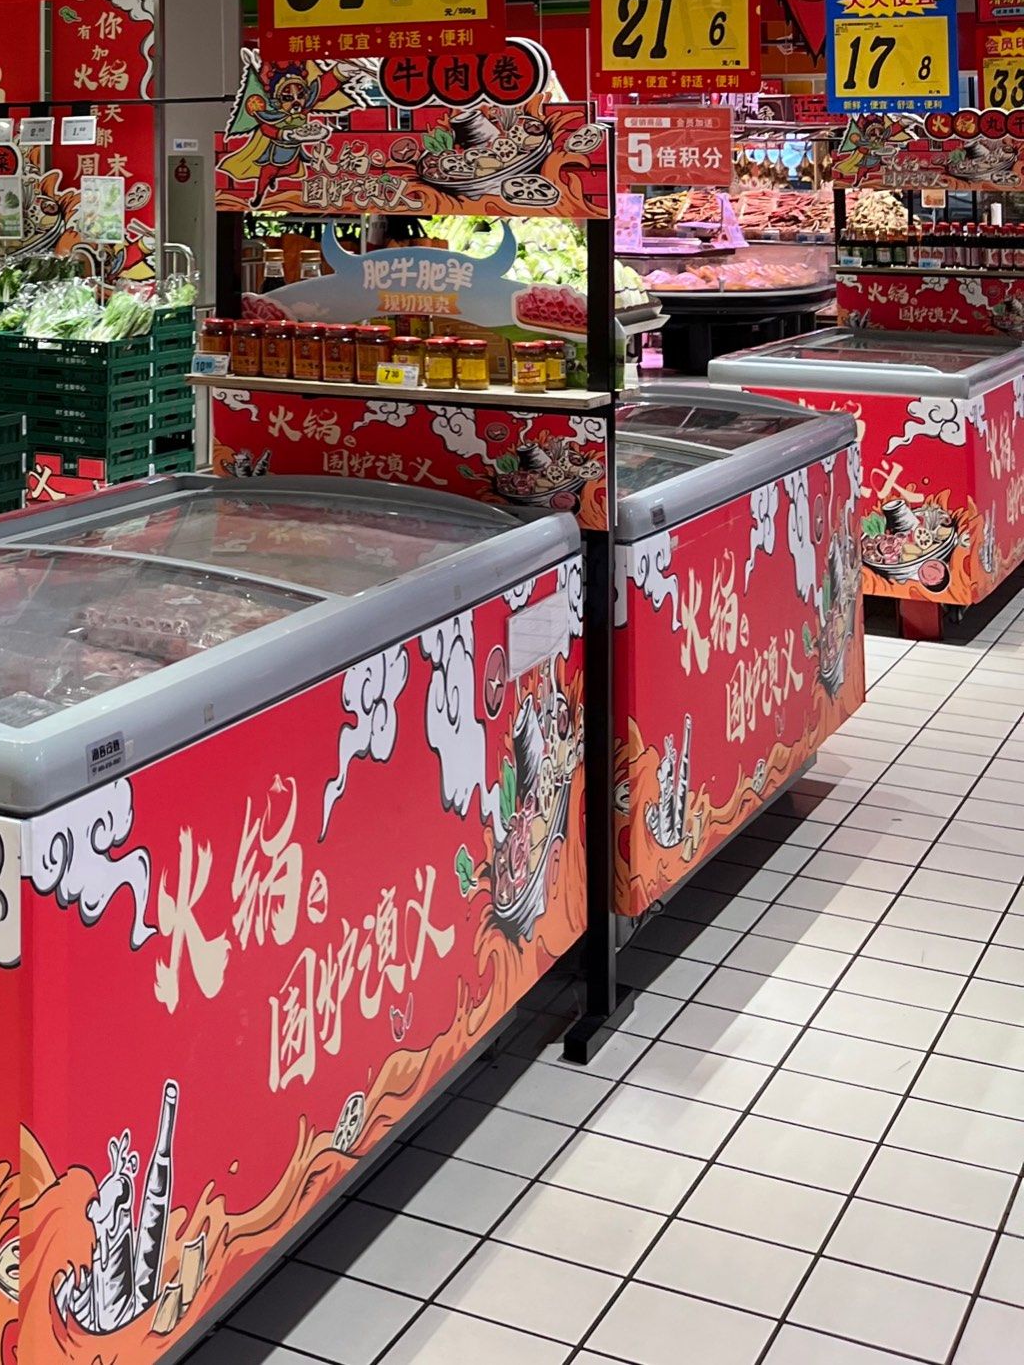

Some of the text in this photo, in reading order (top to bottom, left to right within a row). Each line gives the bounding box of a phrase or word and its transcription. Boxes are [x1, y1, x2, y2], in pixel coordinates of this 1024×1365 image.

[77, 11, 123, 40] 有你
[92, 45, 110, 61] 加
[74, 59, 129, 91] 火锅
[393, 55, 523, 94] 牛肉卷
[74, 151, 133, 177] 周末
[628, 133, 723, 174] 5倍积分
[302, 175, 424, 211] 围炉演义
[362, 257, 474, 291] 肥牛肥羊
[384, 293, 451, 313] 现切现卖
[323, 450, 448, 486] 围炉演义
[726, 629, 804, 744] 围炉演义
[268, 864, 455, 1093] 围炉演义
